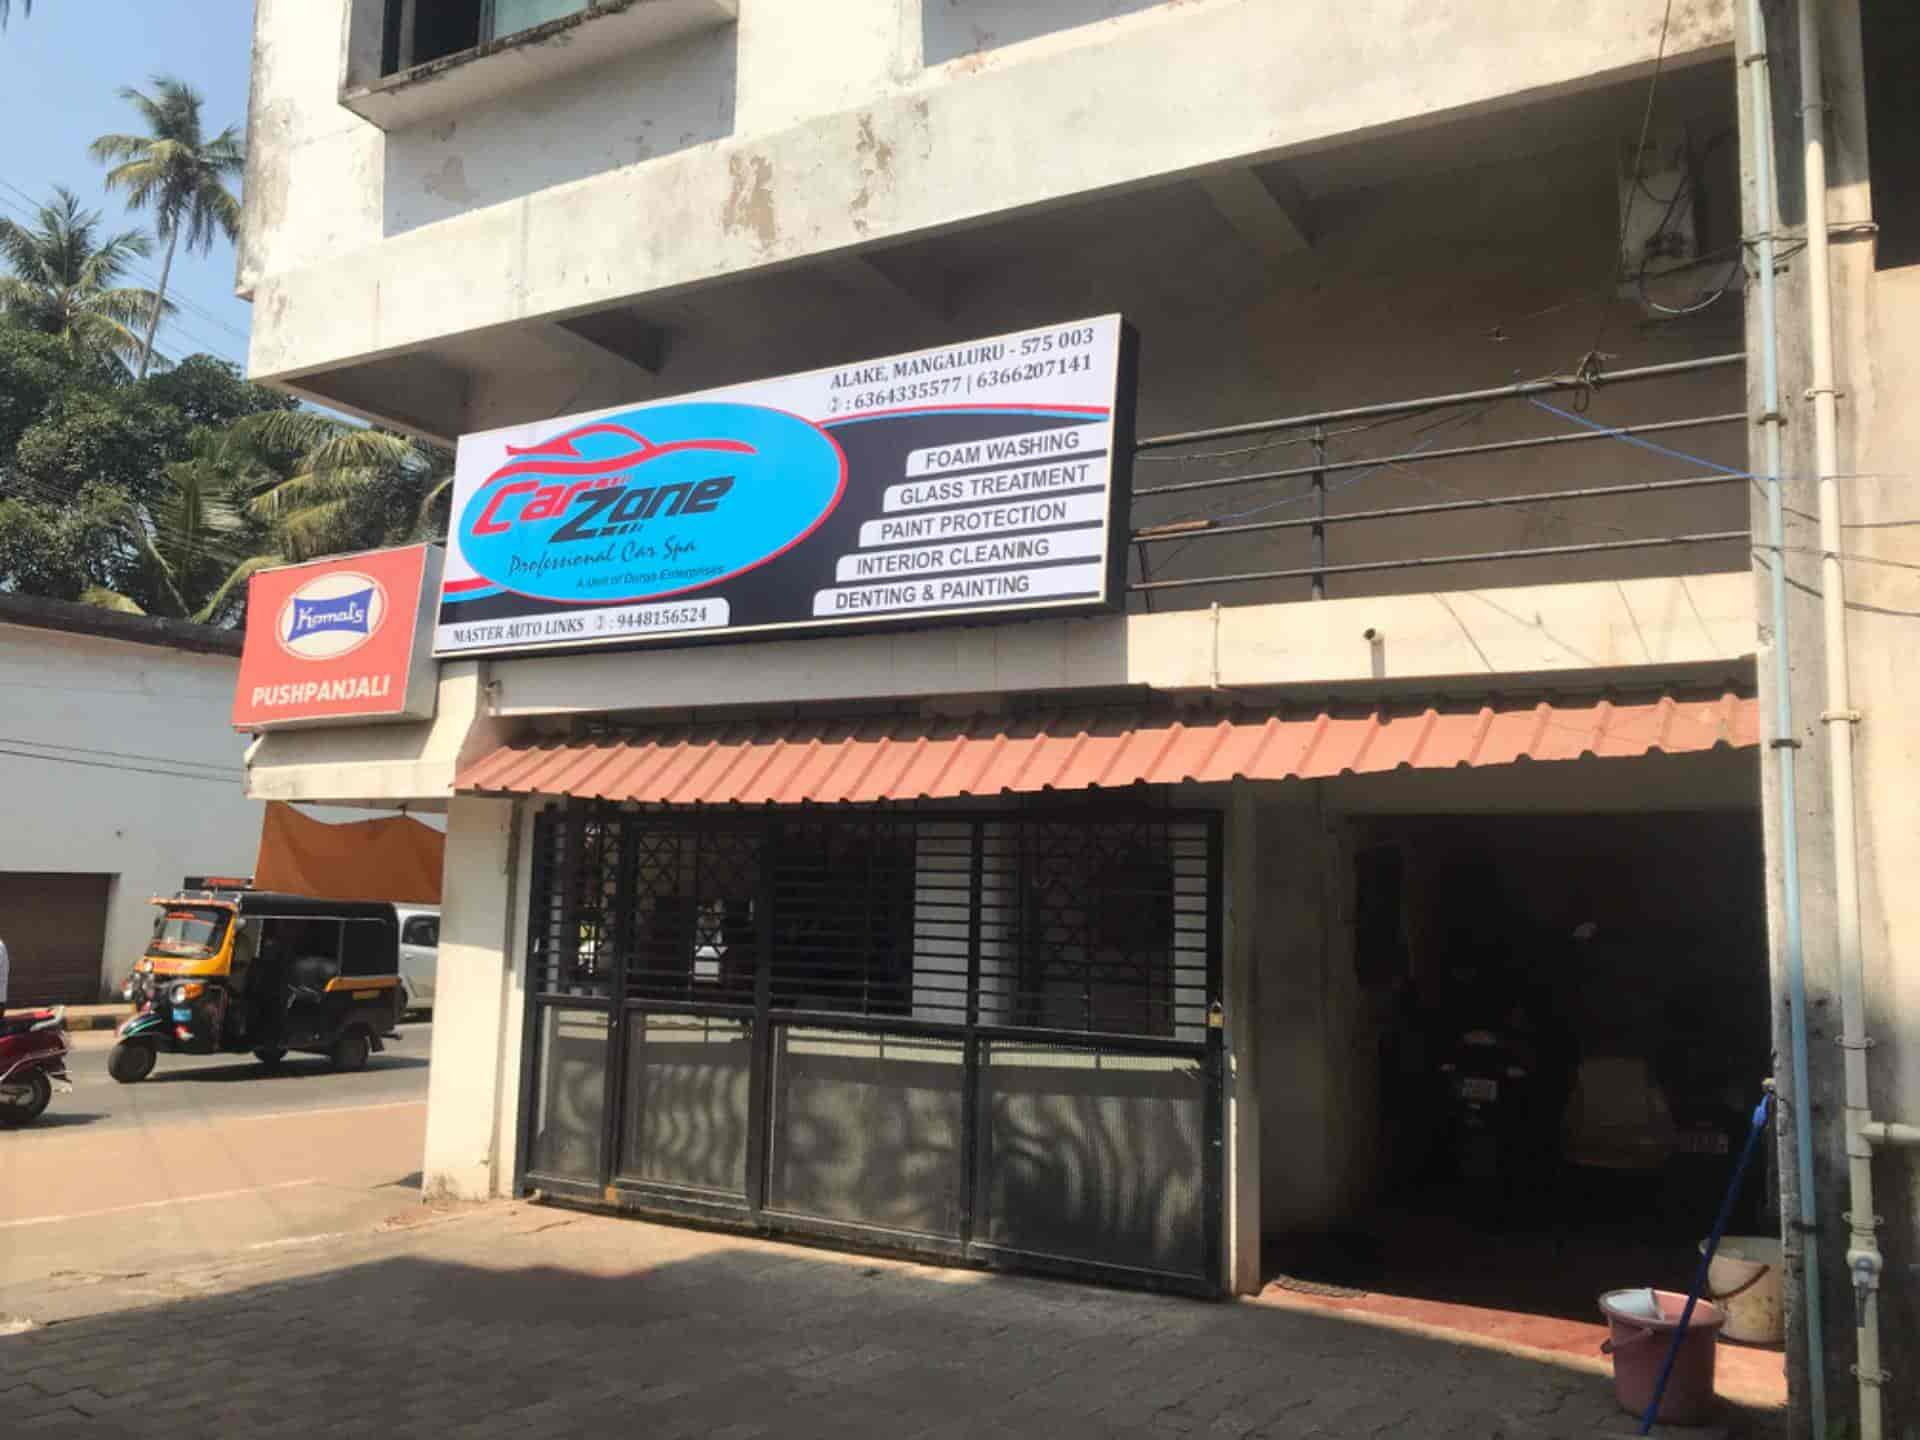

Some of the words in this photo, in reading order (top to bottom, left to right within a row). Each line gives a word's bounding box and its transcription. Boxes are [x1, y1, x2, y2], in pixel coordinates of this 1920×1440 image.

[830, 366, 889, 389] ALAKE,
[892, 343, 1004, 378] MANGALURU
[1020, 334, 1053, 356] 575
[1058, 327, 1094, 349] 003
[976, 354, 1092, 389] 6366207141
[925, 447, 981, 470] FOAM
[986, 431, 1080, 461] WASHING
[900, 481, 963, 505] GLASS
[970, 464, 1089, 496] TREATMENT
[881, 517, 935, 540] PAINT
[941, 502, 1067, 533] PROTECTION
[508, 541, 615, 577] Professional
[621, 540, 656, 562] Car
[664, 535, 697, 561] Spa
[857, 548, 943, 575] INTERIOR
[949, 539, 1049, 566] CLEANING
[835, 585, 916, 610] DENTING
[922, 582, 935, 601] &
[941, 575, 1030, 599] PAINTING
[453, 624, 503, 644] MASTER
[506, 621, 542, 639] AUTO
[545, 618, 585, 635] LINKS
[252, 674, 391, 708] PUSHPANJALI
